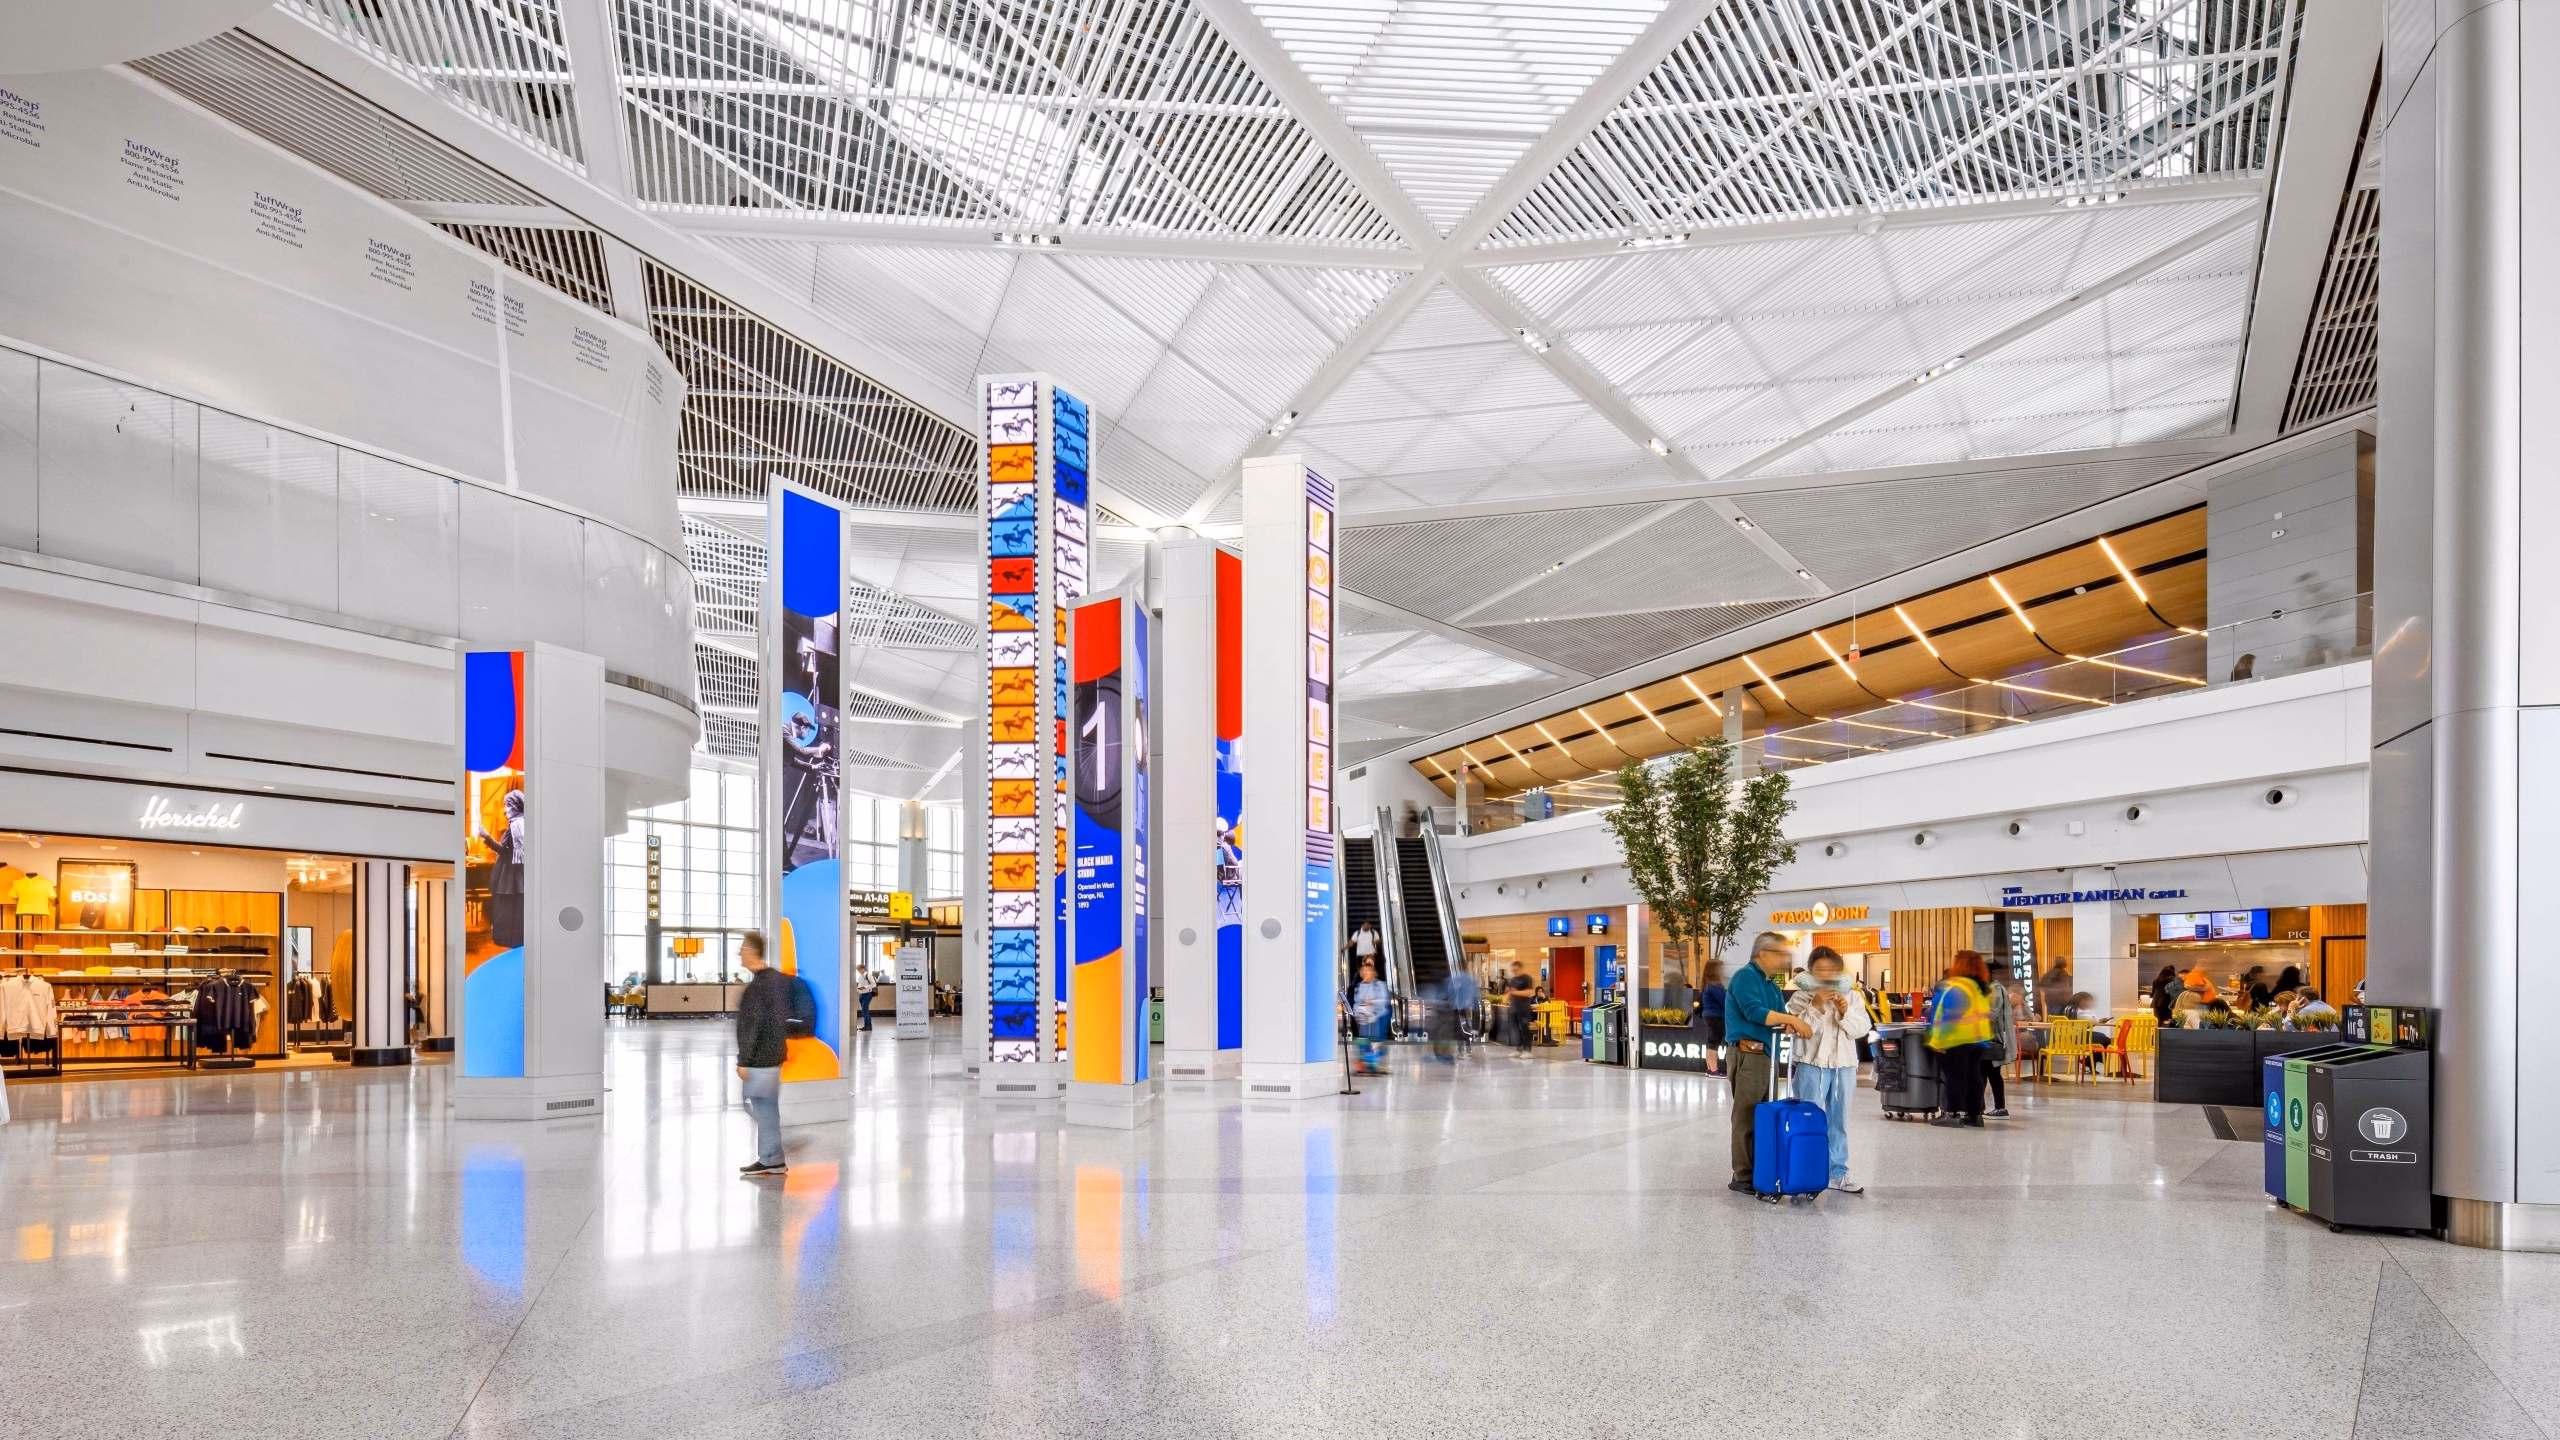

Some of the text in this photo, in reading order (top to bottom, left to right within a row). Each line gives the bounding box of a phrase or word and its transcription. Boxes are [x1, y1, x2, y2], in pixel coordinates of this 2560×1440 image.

[3, 111, 46, 131] Retardant
[124, 139, 179, 166] TuffWrap
[124, 149, 180, 175] 800-995-4556
[121, 157, 184, 185] Flame Retardant
[133, 171, 173, 190] Anti-Static
[127, 178, 180, 201] Anti-Microbial
[254, 191, 302, 216] TuffWrap
[254, 200, 302, 224] 800-995-4556
[250, 208, 306, 233] Flame Retardant
[261, 221, 296, 238] Anti-Static
[256, 228, 302, 248] Anti-Microbial
[1309, 509, 1328, 827] FORT LEE
[139, 795, 243, 829] Herschel
[1077, 857, 1094, 867] BLACK
[71, 890, 118, 903] BOSS
[864, 893, 889, 903] A1-A8
[1077, 883, 1096, 891] Opened
[2002, 888, 2188, 907] MEDITERRANEAN GRILL
[2011, 921, 2022, 980] BITES
